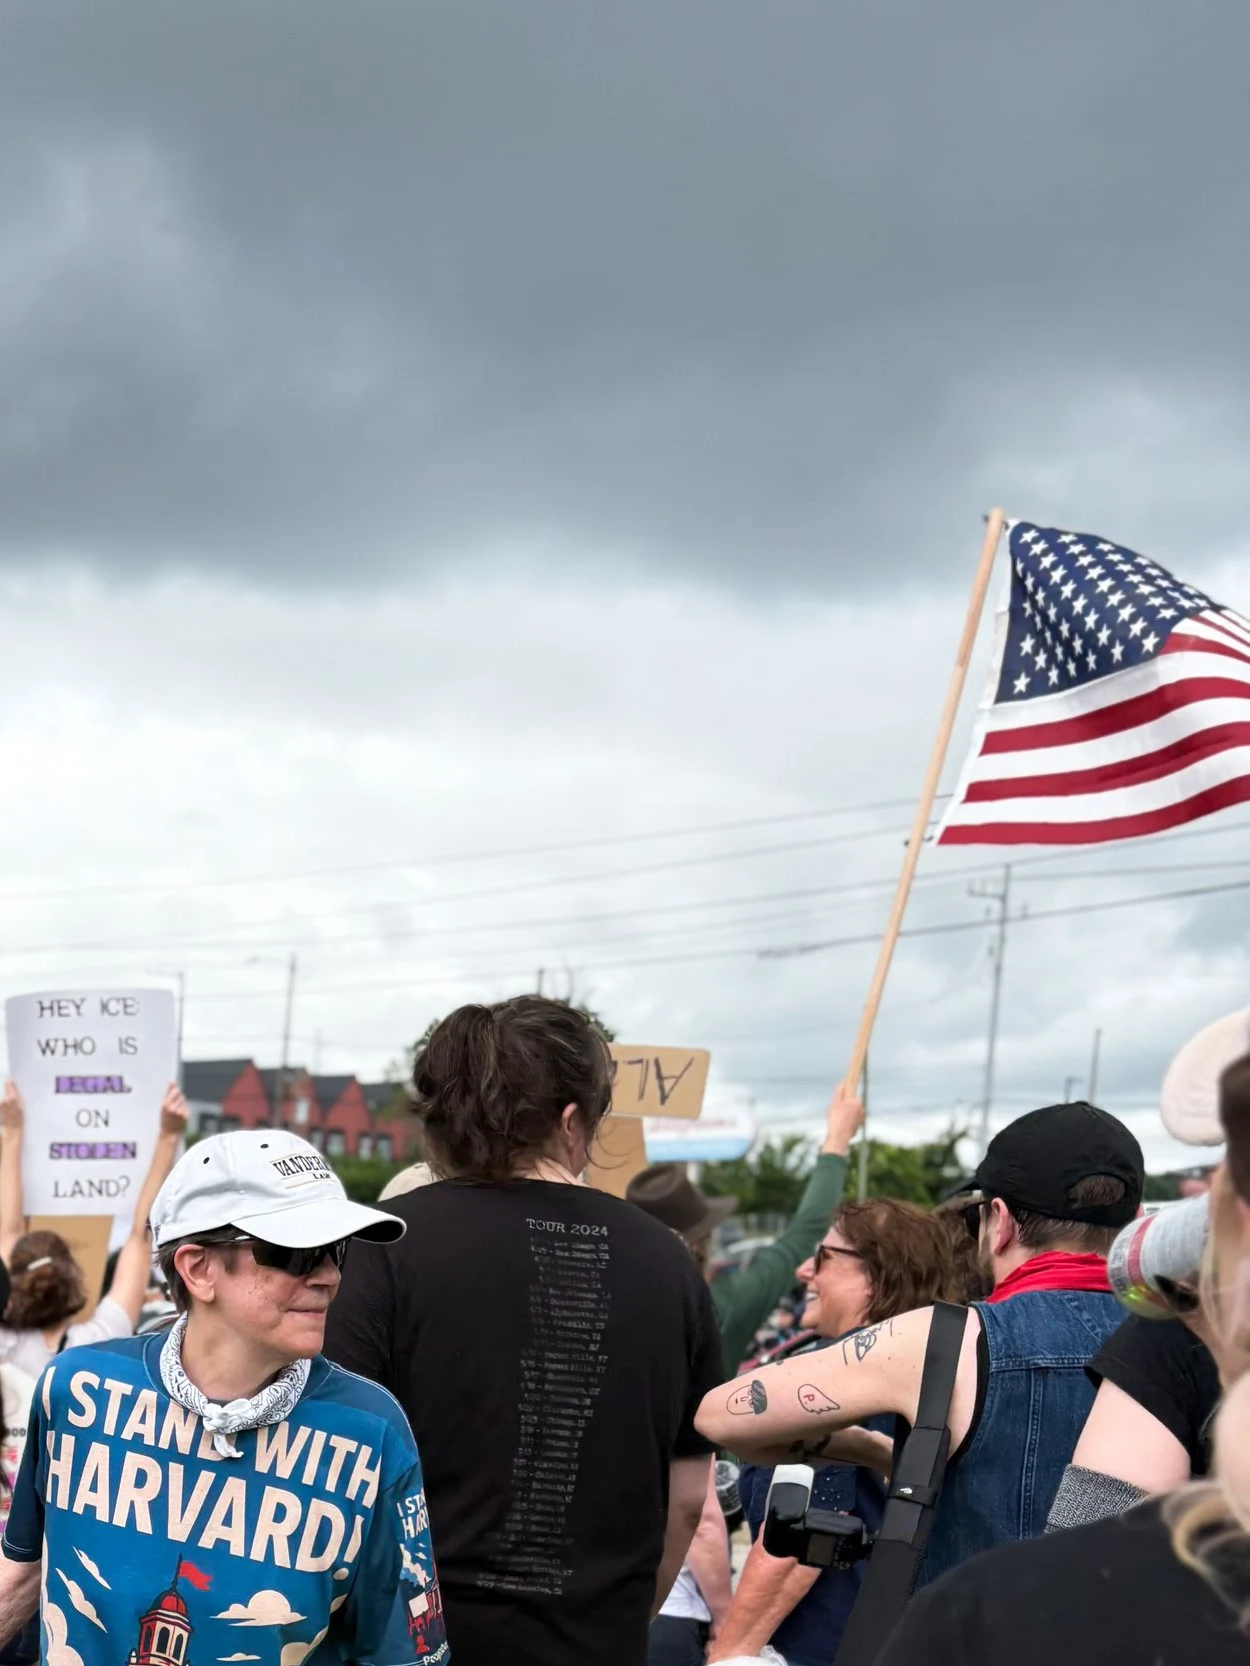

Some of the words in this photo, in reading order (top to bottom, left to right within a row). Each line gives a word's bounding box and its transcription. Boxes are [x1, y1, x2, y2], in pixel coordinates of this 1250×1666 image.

[37, 997, 86, 1019] HEY
[37, 1036, 96, 1057] WHO
[118, 1036, 139, 1056] IS
[54, 1075, 133, 1095] LEGAL
[612, 1056, 695, 1106] AL
[75, 1108, 110, 1129] ON
[49, 1141, 138, 1161] STOLEN
[53, 1175, 131, 1199] LAND?
[525, 1218, 566, 1233] TOUR
[570, 1223, 609, 1237] 2024
[41, 1366, 56, 1422] I
[254, 1421, 382, 1508] WITH
[46, 1430, 365, 1581] HARVARD!
[405, 1488, 426, 1514] STA
